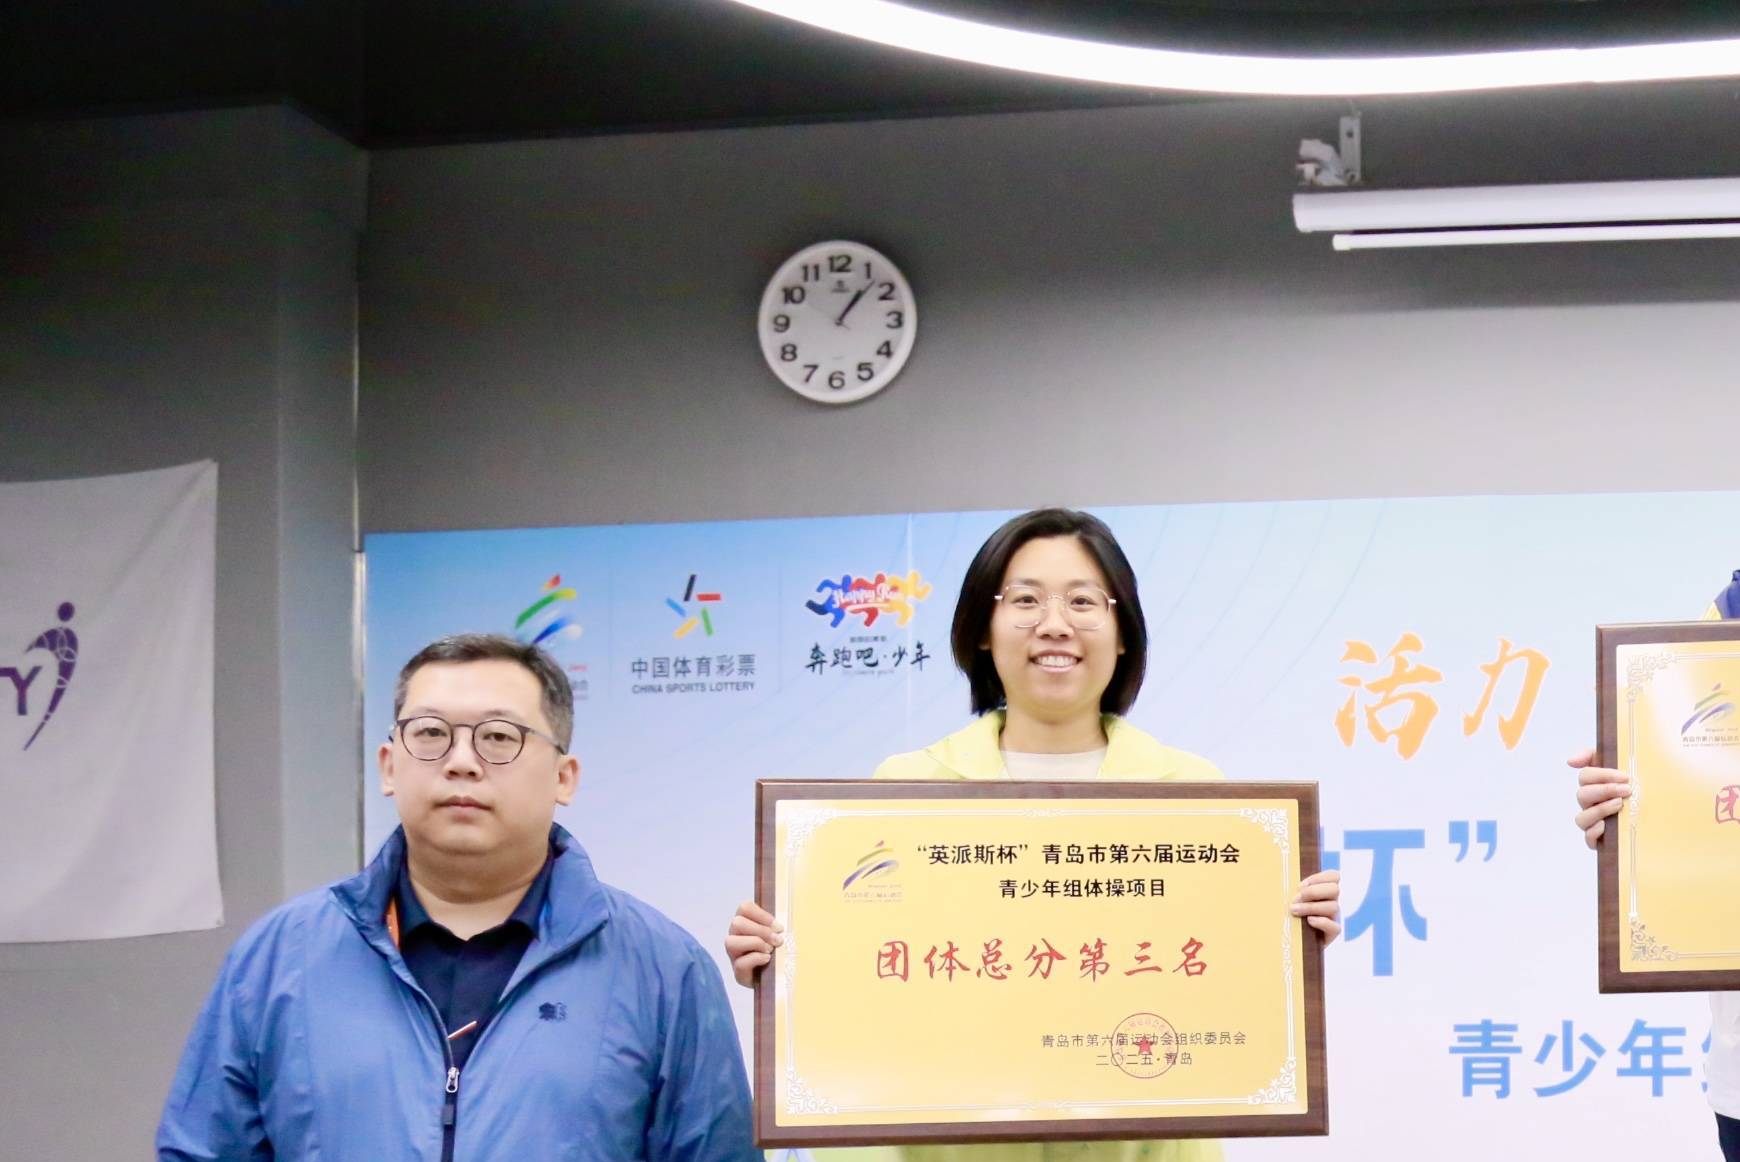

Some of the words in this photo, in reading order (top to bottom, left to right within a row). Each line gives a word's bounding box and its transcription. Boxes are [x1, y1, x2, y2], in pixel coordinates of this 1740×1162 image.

[802, 264, 820, 282] 11
[828, 254, 852, 273] 12
[864, 262, 872, 279] 1
[783, 286, 805, 304] 10
[878, 282, 895, 300] 2
[773, 314, 790, 333] 9
[886, 311, 903, 329] 3
[780, 343, 797, 362] 8
[876, 340, 893, 358] 4
[803, 365, 819, 383] 7
[828, 371, 845, 390] 6
[857, 362, 874, 381] 5
[632, 654, 756, 679] 中国体育彩票
[631, 684, 663, 695] CHINA
[666, 683, 707, 694] SPORTS
[709, 681, 755, 692] LOTTERY
[1334, 632, 1549, 760] 活力
[999, 878, 1167, 898] 青少年组体操项目
[877, 937, 1209, 983] 团体总分第三名
[1449, 1019, 1711, 1099] 青少年
